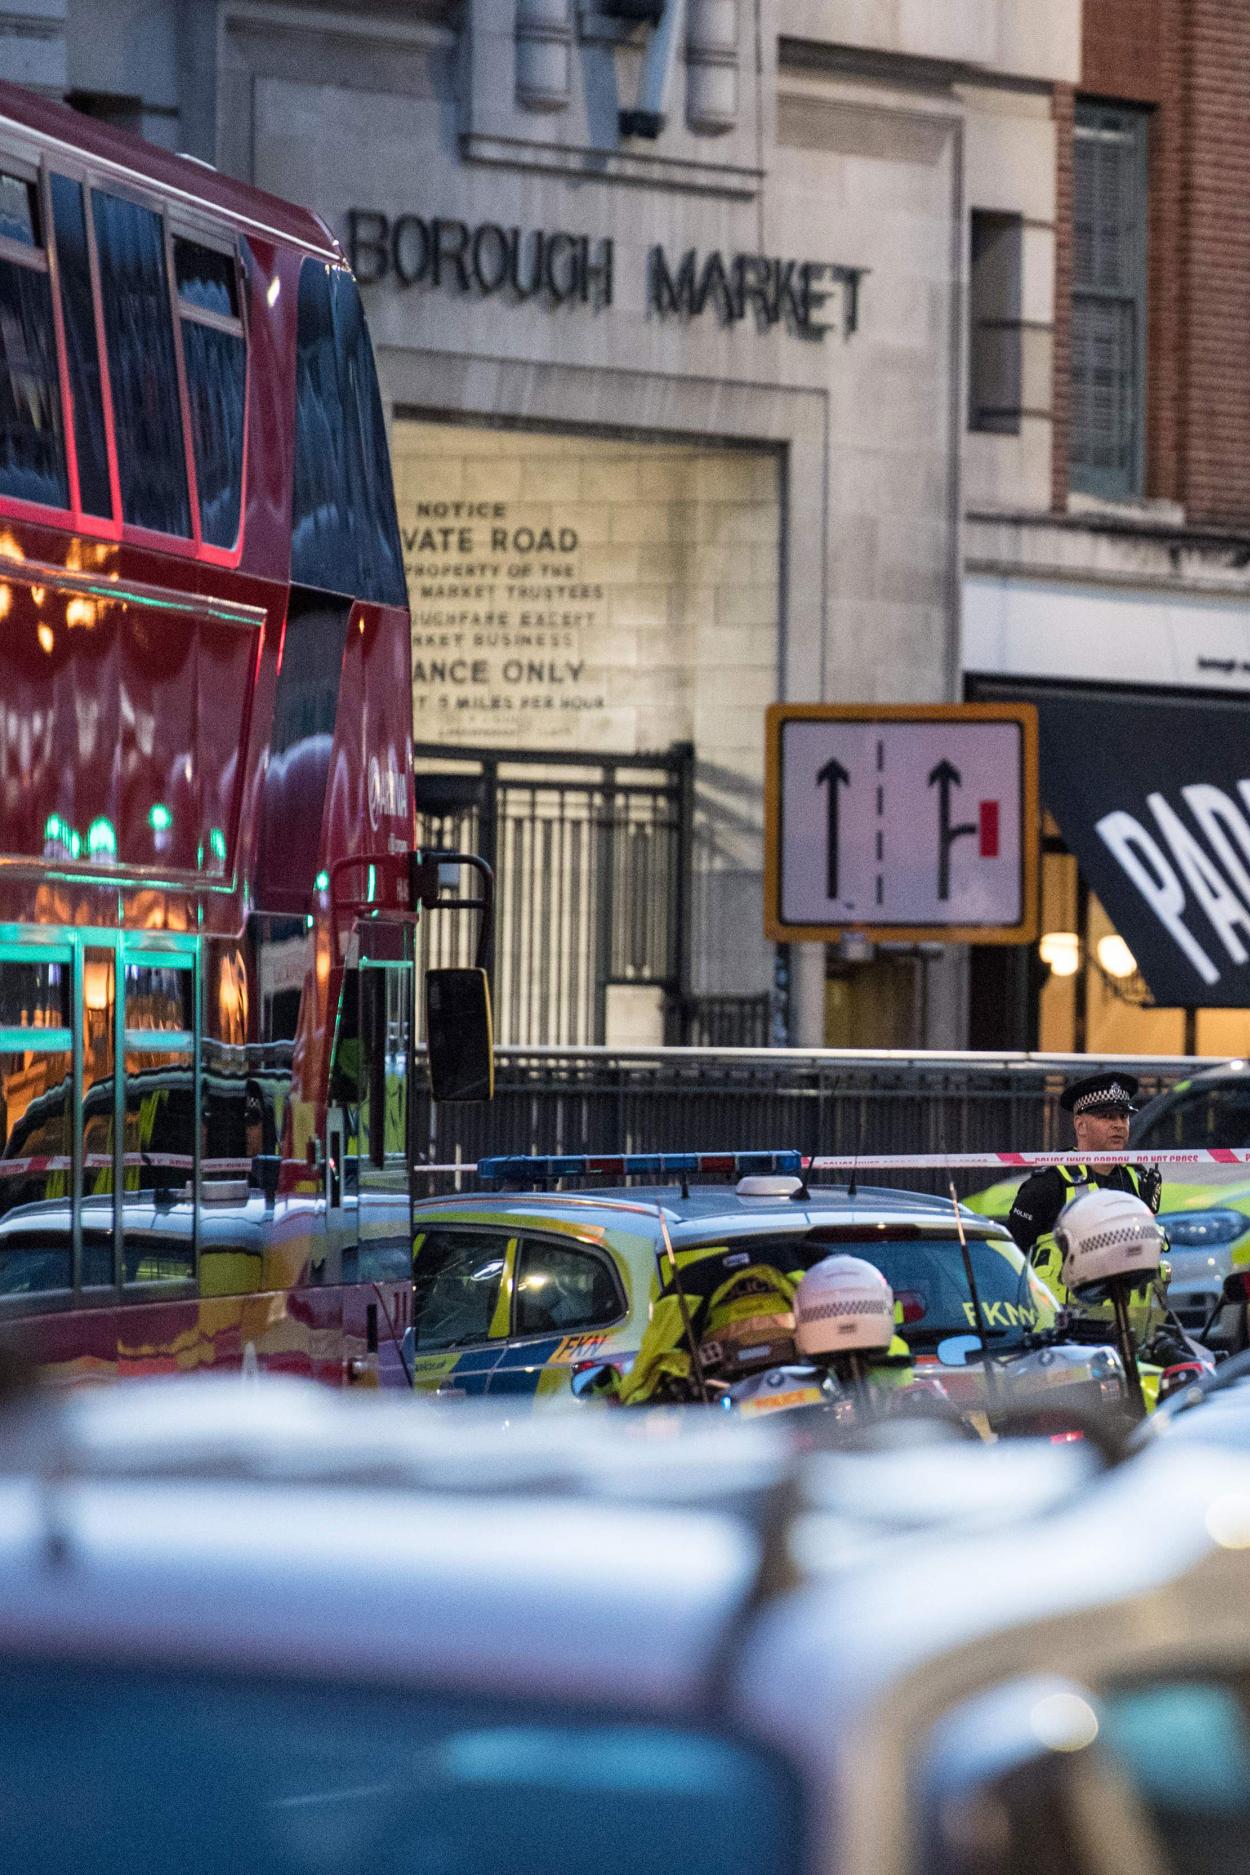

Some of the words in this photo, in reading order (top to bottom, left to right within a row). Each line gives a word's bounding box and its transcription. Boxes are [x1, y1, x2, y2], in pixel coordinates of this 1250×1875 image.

[347, 208, 614, 305] BOROUGH
[647, 244, 872, 341] MARKET
[417, 502, 506, 518] NOTICE
[402, 527, 473, 553] VATE
[491, 527, 578, 553] ROAD
[507, 563, 532, 578] OF
[541, 563, 574, 577] THE
[421, 584, 496, 598] MARKET
[506, 583, 603, 600] TRUSTEES
[413, 633, 464, 647] RKET
[413, 660, 489, 684] ANCE
[503, 659, 584, 684] ONLY
[456, 697, 512, 709] MILES
[520, 697, 554, 709] PER
[560, 697, 604, 709] HOUR
[1013, 1207, 1033, 1221] POLICE
